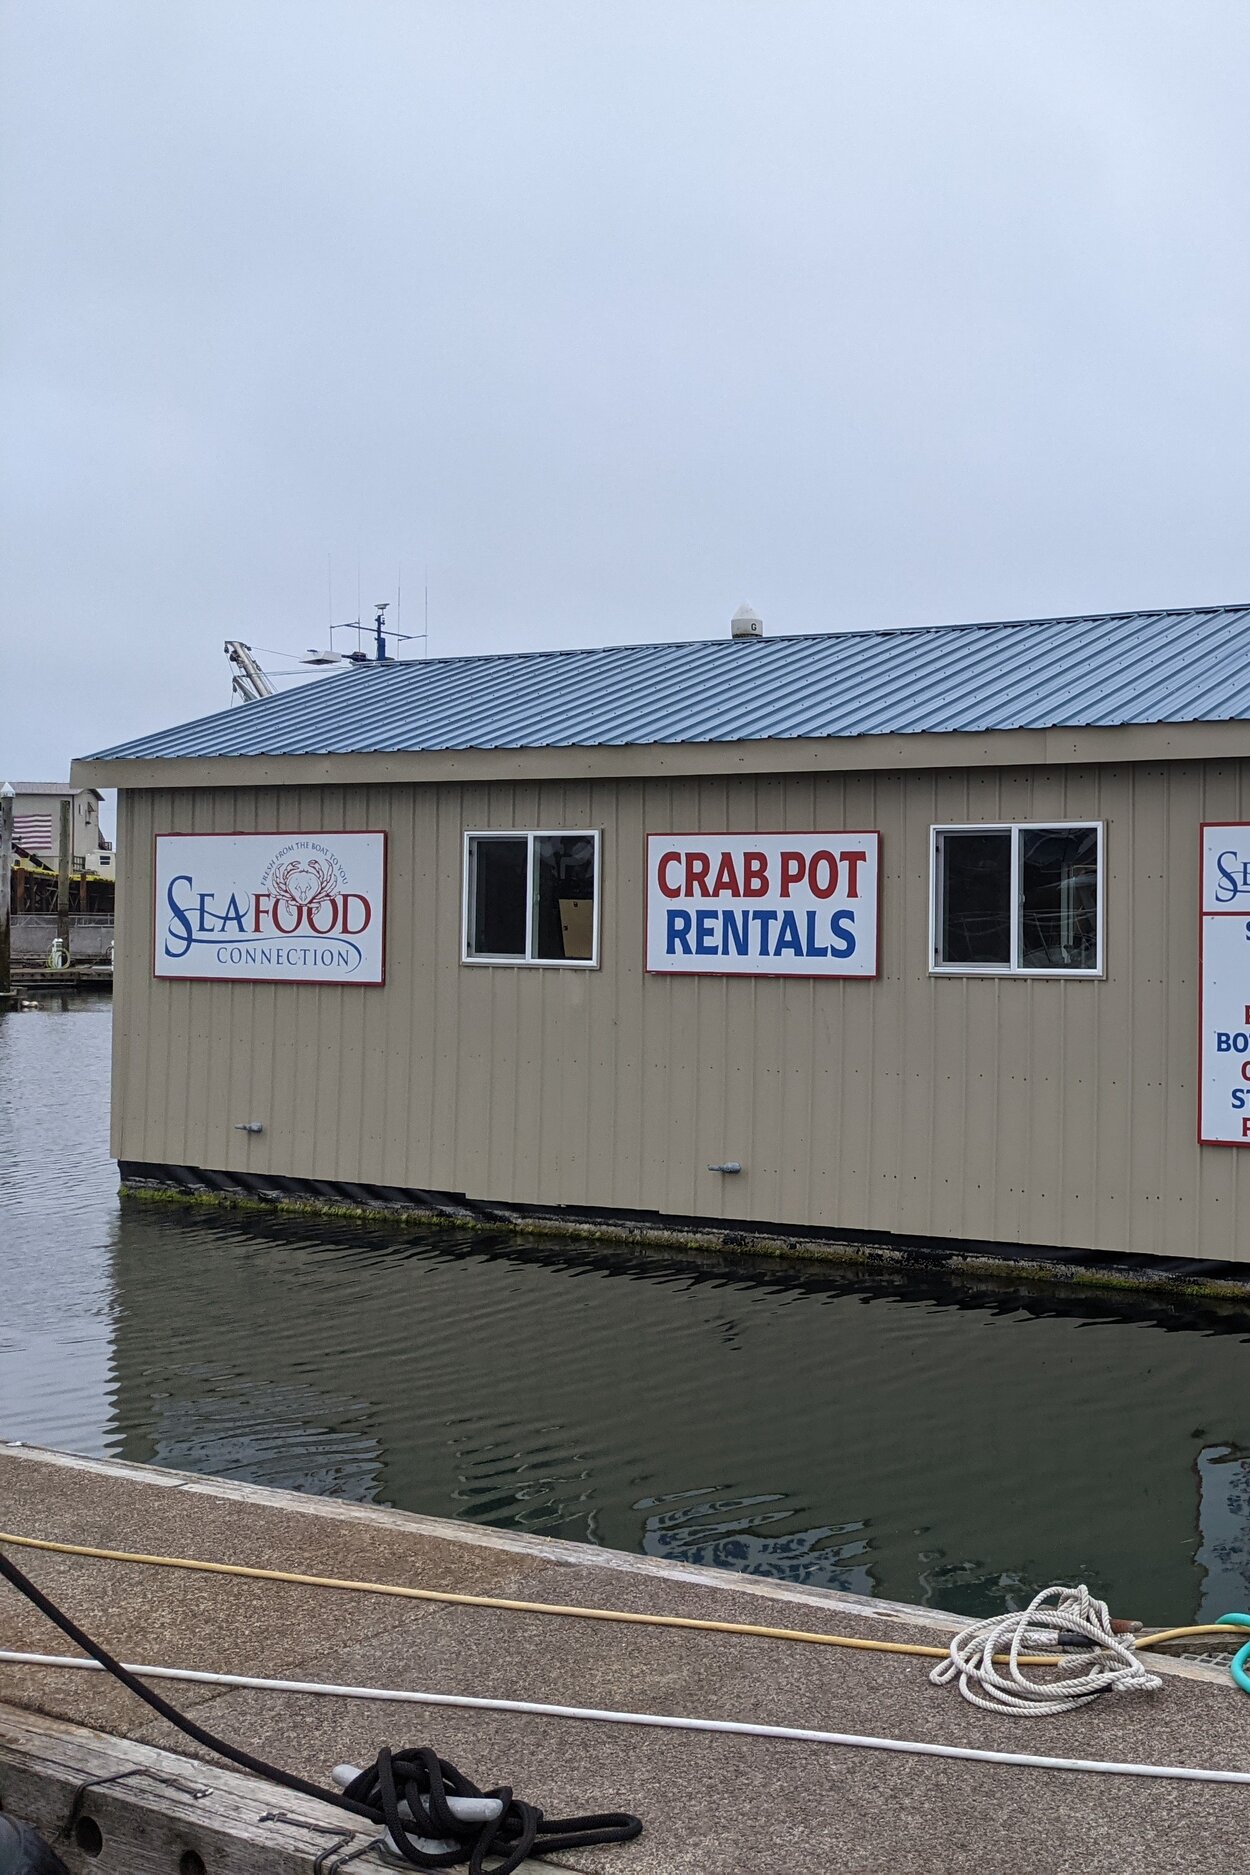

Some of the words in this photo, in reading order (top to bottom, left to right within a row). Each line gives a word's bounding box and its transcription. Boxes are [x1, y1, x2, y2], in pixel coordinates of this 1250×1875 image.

[260, 860, 276, 886] FRESH
[275, 844, 295, 862] FROM
[295, 841, 309, 850] THE
[311, 843, 329, 856] BOAT
[329, 853, 339, 866] TO
[337, 864, 349, 885] YOU
[657, 850, 770, 899] CRAB
[779, 849, 867, 899] POT
[164, 875, 372, 958] SEAFOOD
[665, 908, 856, 959] RENTALS
[216, 946, 350, 967] CONNECTION
